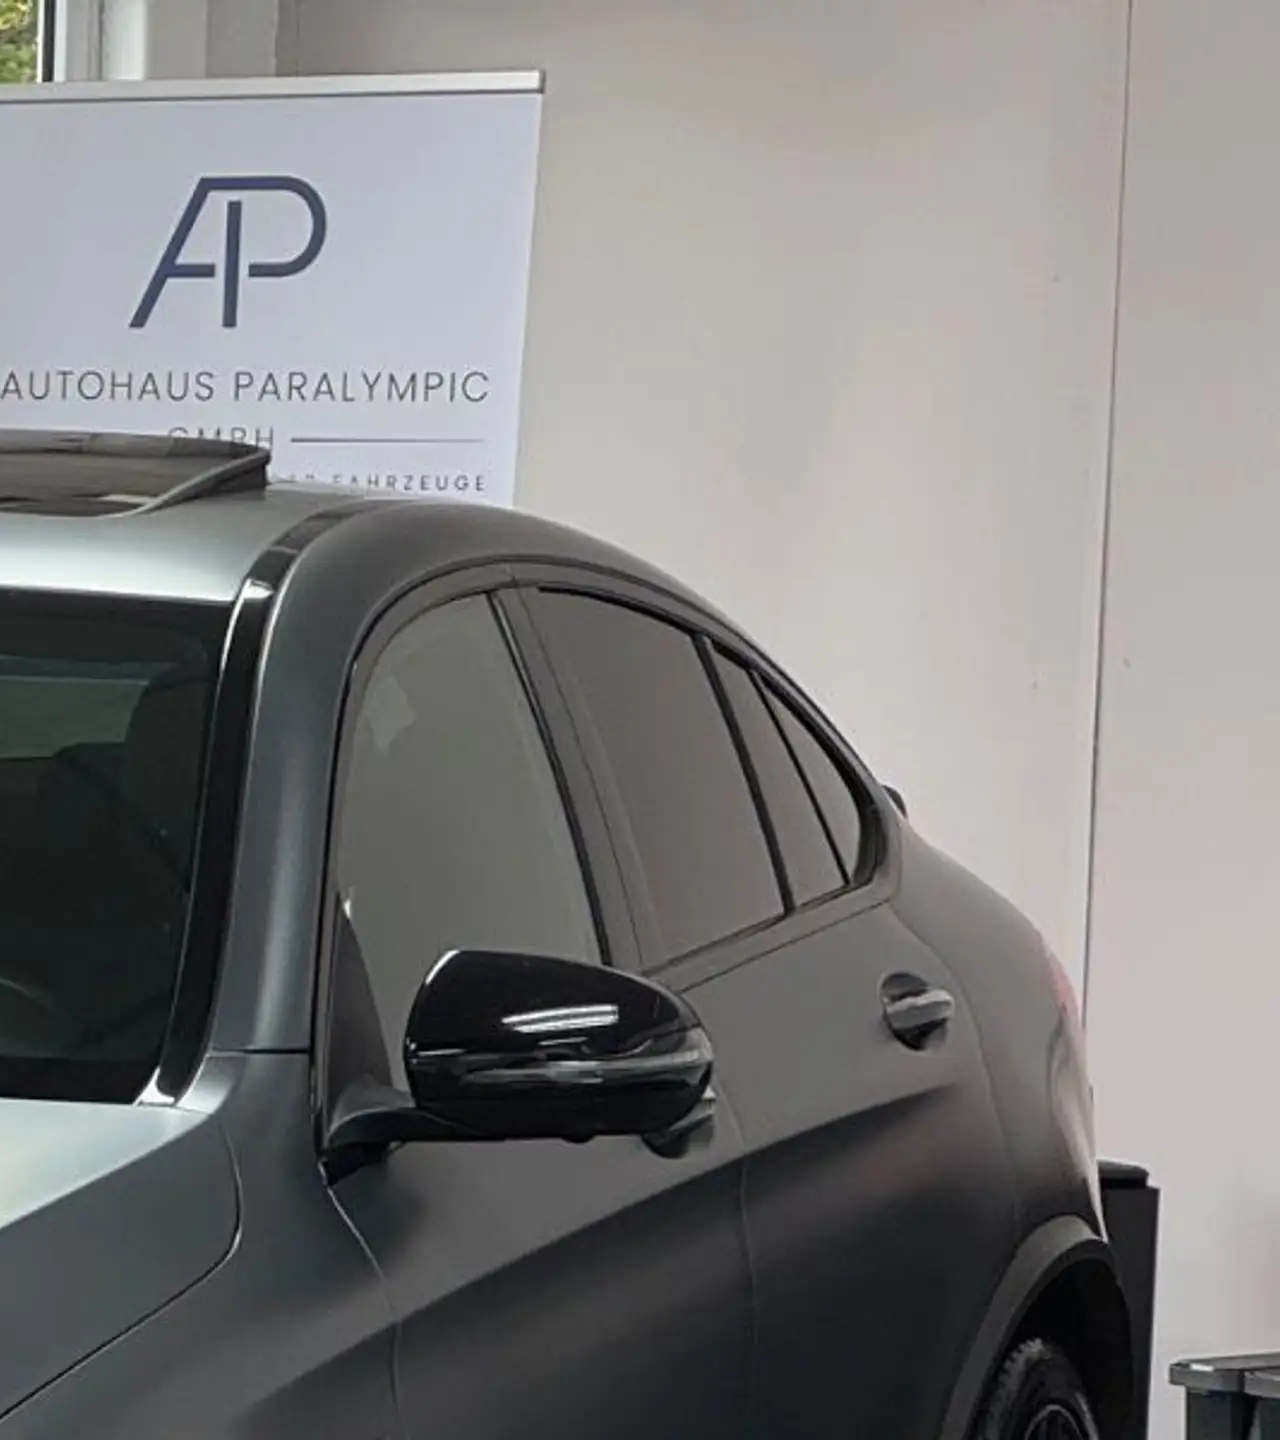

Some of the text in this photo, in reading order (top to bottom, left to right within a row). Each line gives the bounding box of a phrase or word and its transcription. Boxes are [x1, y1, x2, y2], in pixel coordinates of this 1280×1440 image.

[129, 175, 328, 328] AP
[0, 370, 490, 402] AUTOHAUS PARALYMPIC
